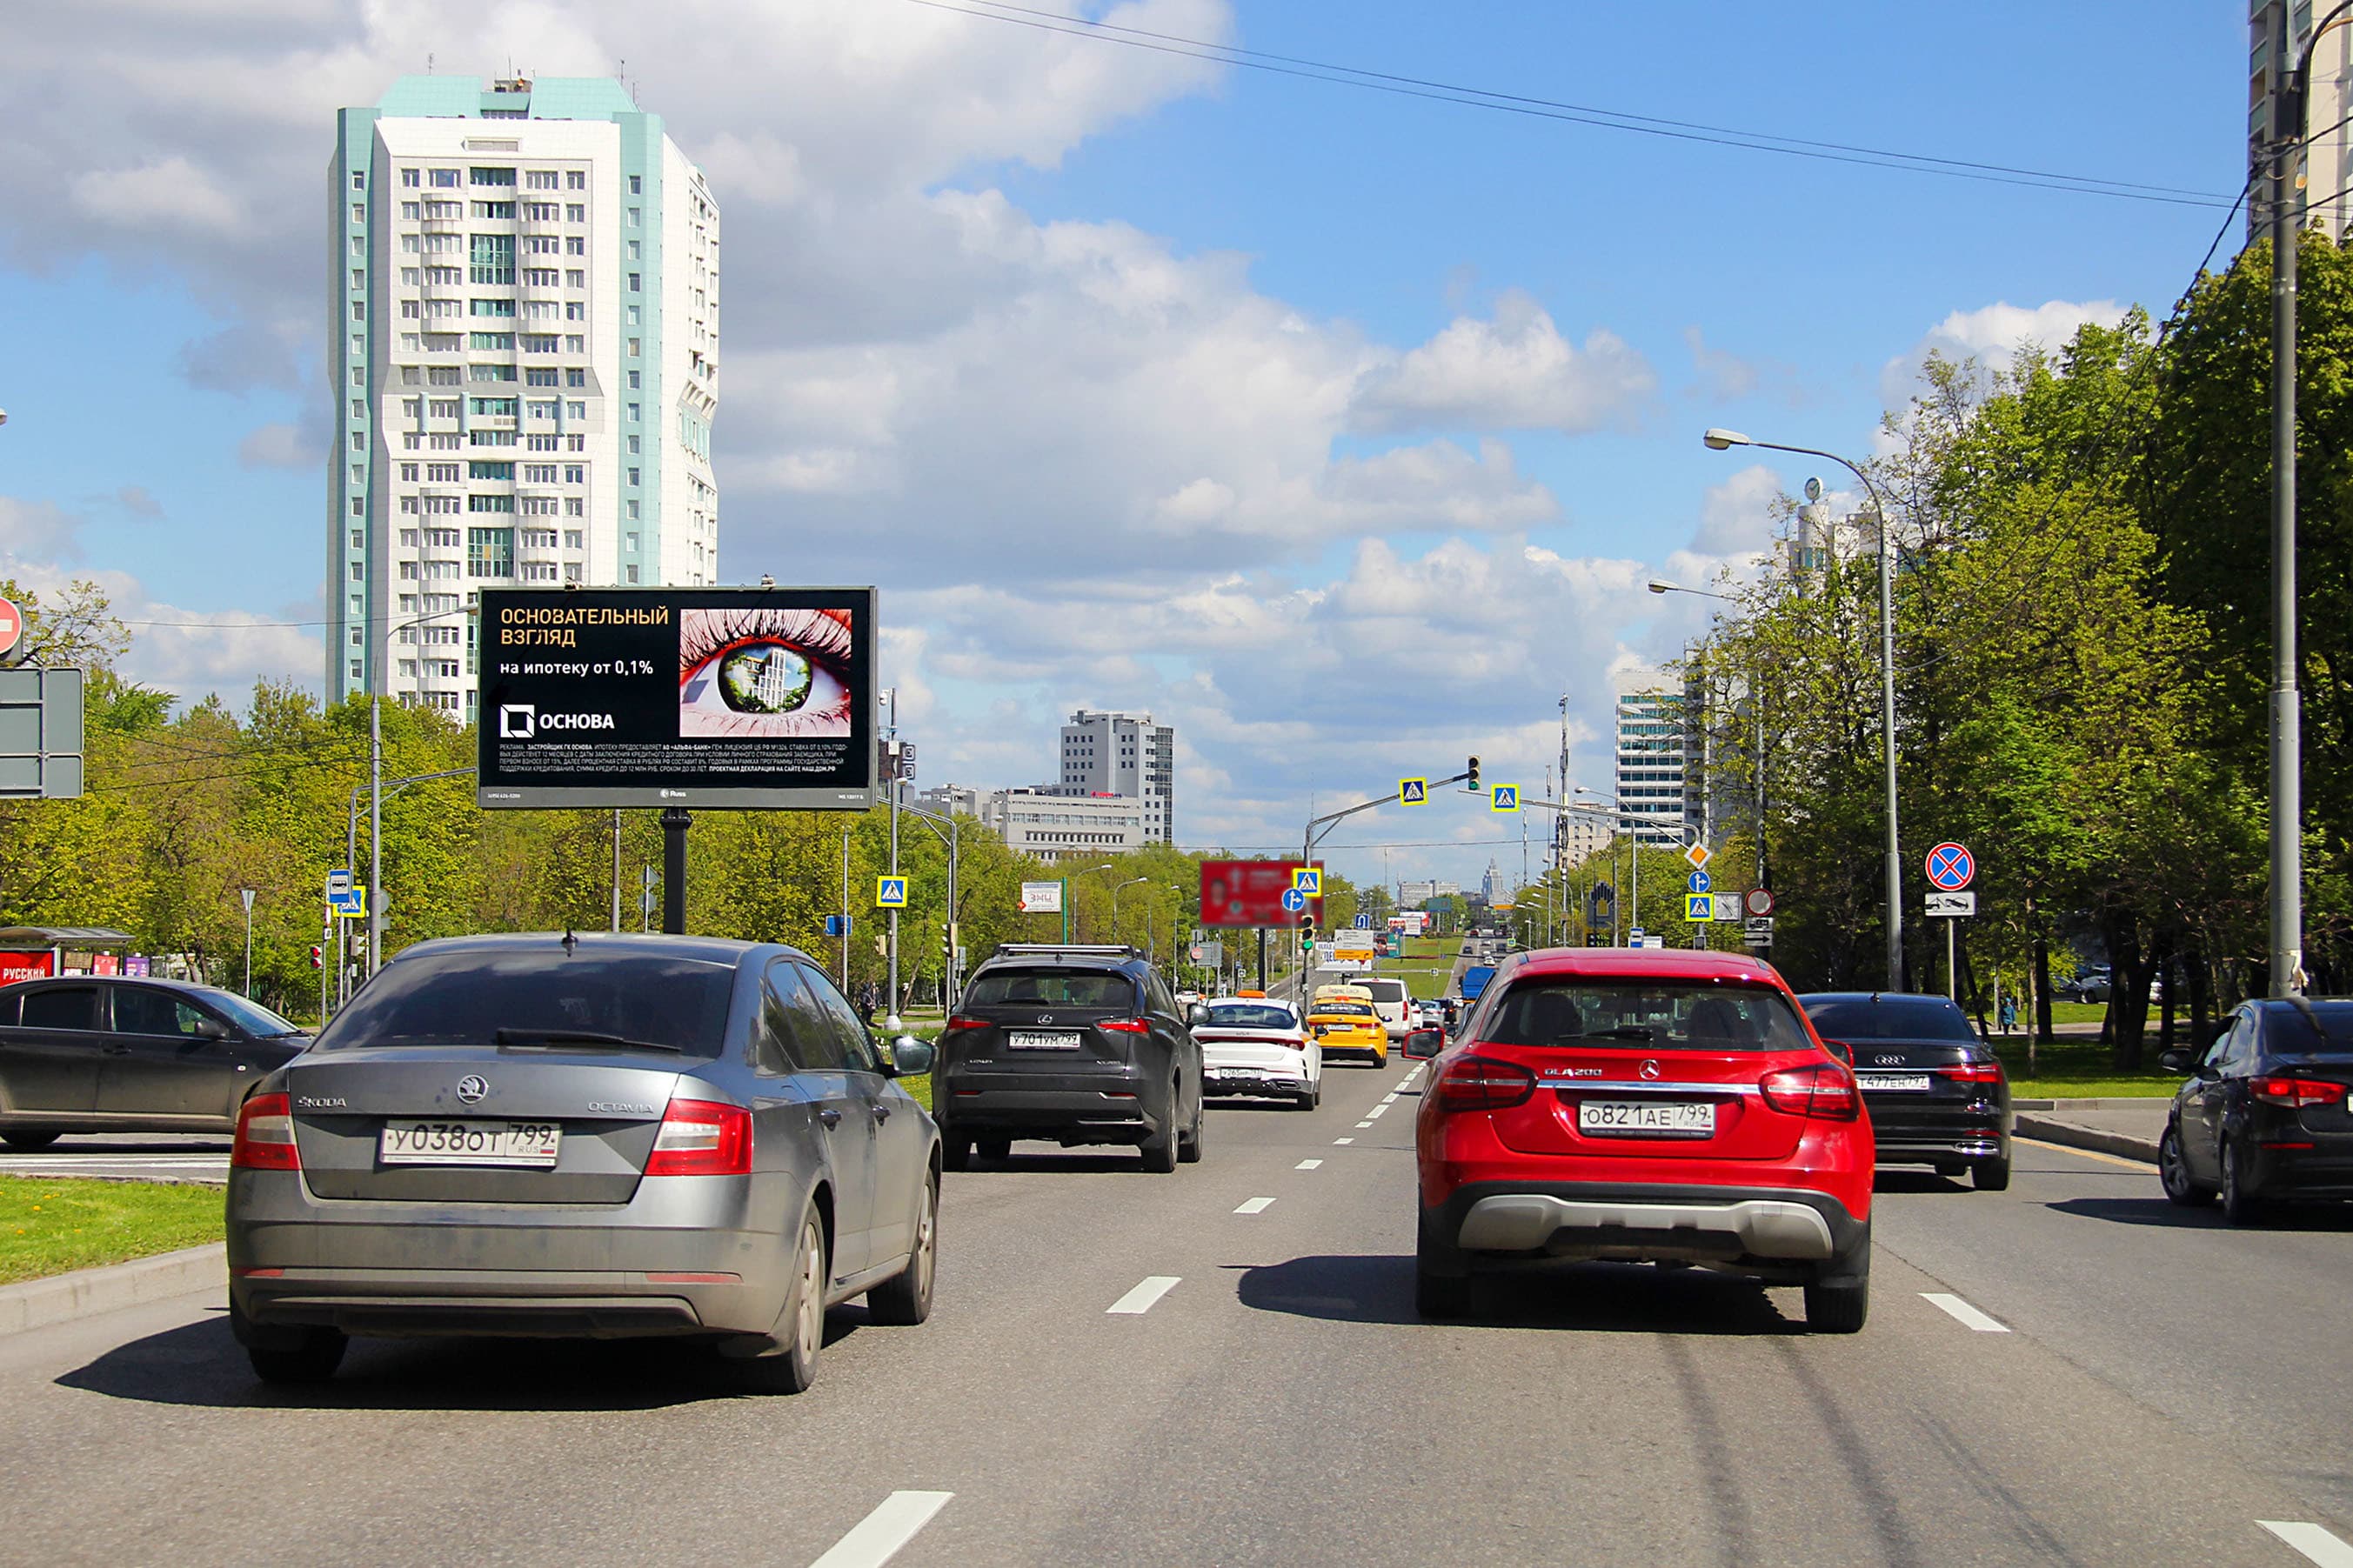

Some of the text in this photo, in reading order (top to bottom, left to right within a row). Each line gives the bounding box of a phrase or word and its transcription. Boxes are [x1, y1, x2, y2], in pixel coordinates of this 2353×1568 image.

[500, 605, 669, 625] ОСНОВАТЕЛЬНЫЙ
[500, 629, 576, 648] ВЗГЛЯД
[499, 660, 654, 677] на ипотеку от 0,1%
[539, 714, 615, 730] ОСНОВА
[3, 967, 45, 980] РУССКИЙ
[297, 1096, 347, 1108] ŠKODA
[587, 1101, 654, 1114] OCTAVIA
[1587, 1104, 1709, 1126] О821АЕ 799
[395, 1124, 551, 1151] У038ОТ 799
[518, 1144, 539, 1154] RUS
